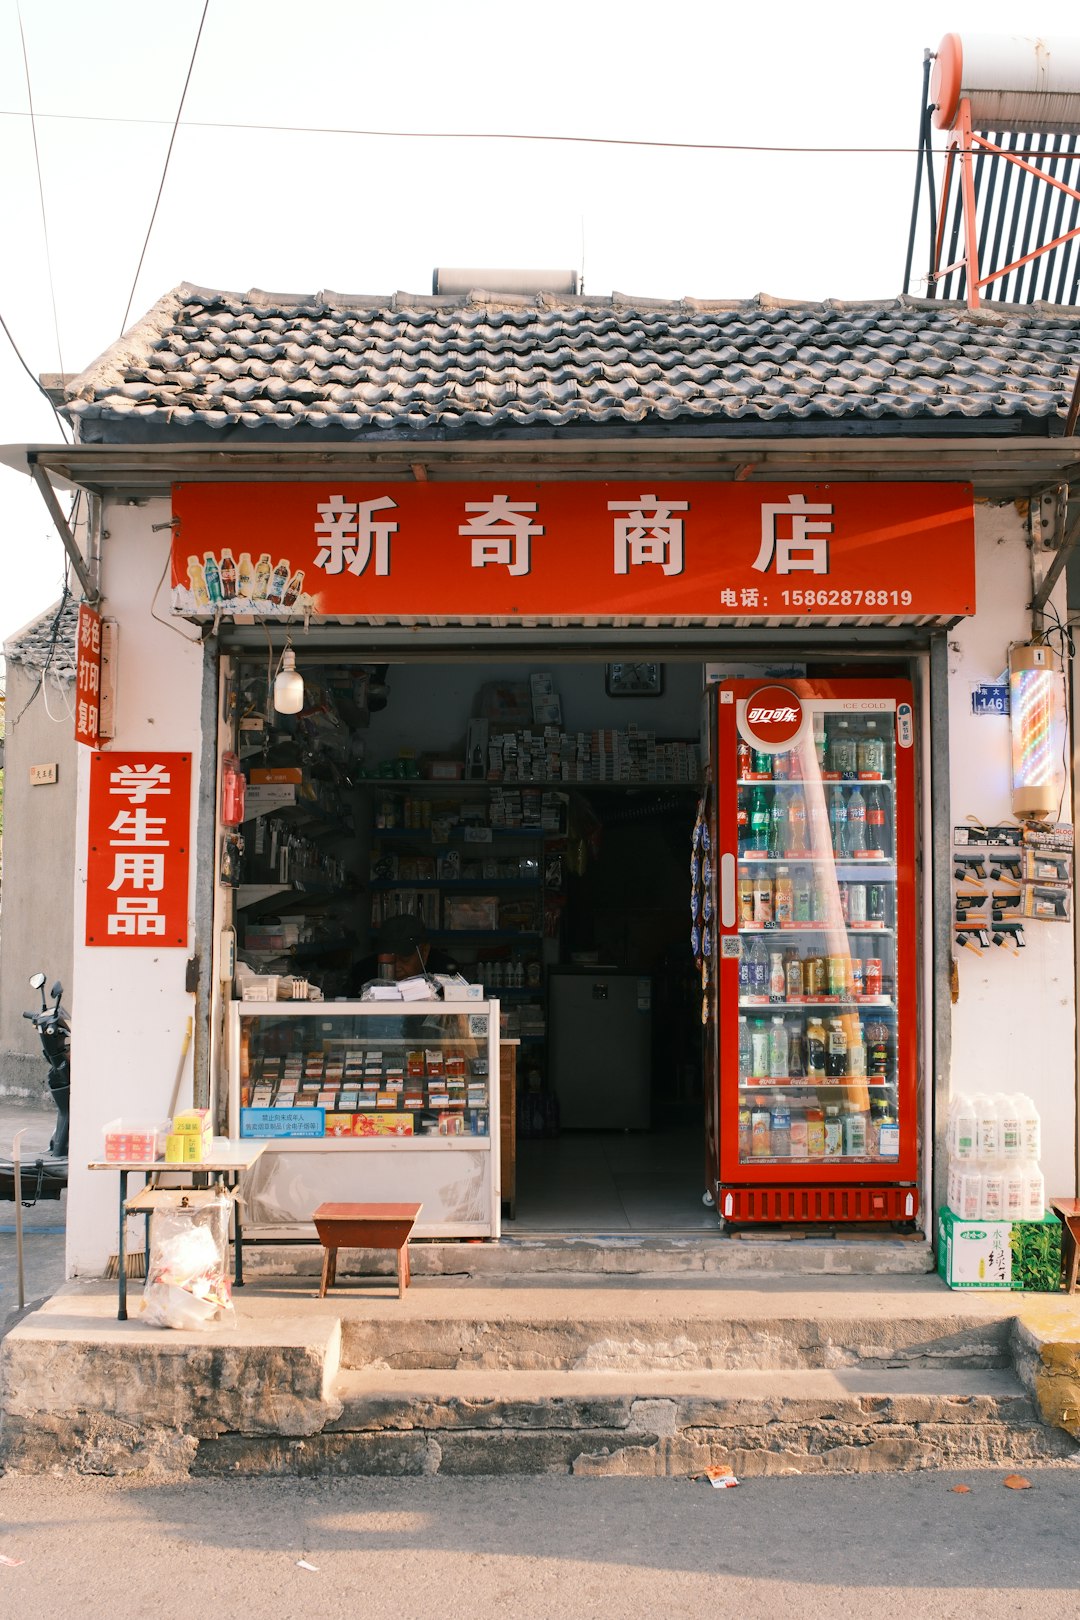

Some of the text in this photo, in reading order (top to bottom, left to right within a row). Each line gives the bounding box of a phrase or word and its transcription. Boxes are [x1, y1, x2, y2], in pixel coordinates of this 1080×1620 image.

[313, 494, 832, 577] 新奇商店
[782, 589, 913, 606] 15862878819
[80, 613, 101, 653] 彩色
[78, 656, 100, 696] 打印
[77, 698, 99, 739] 复印
[748, 707, 800, 724] 可口可乐
[981, 698, 1003, 710] 146
[107, 764, 171, 936] 学生用品
[1056, 828, 1074, 836] GLOC
